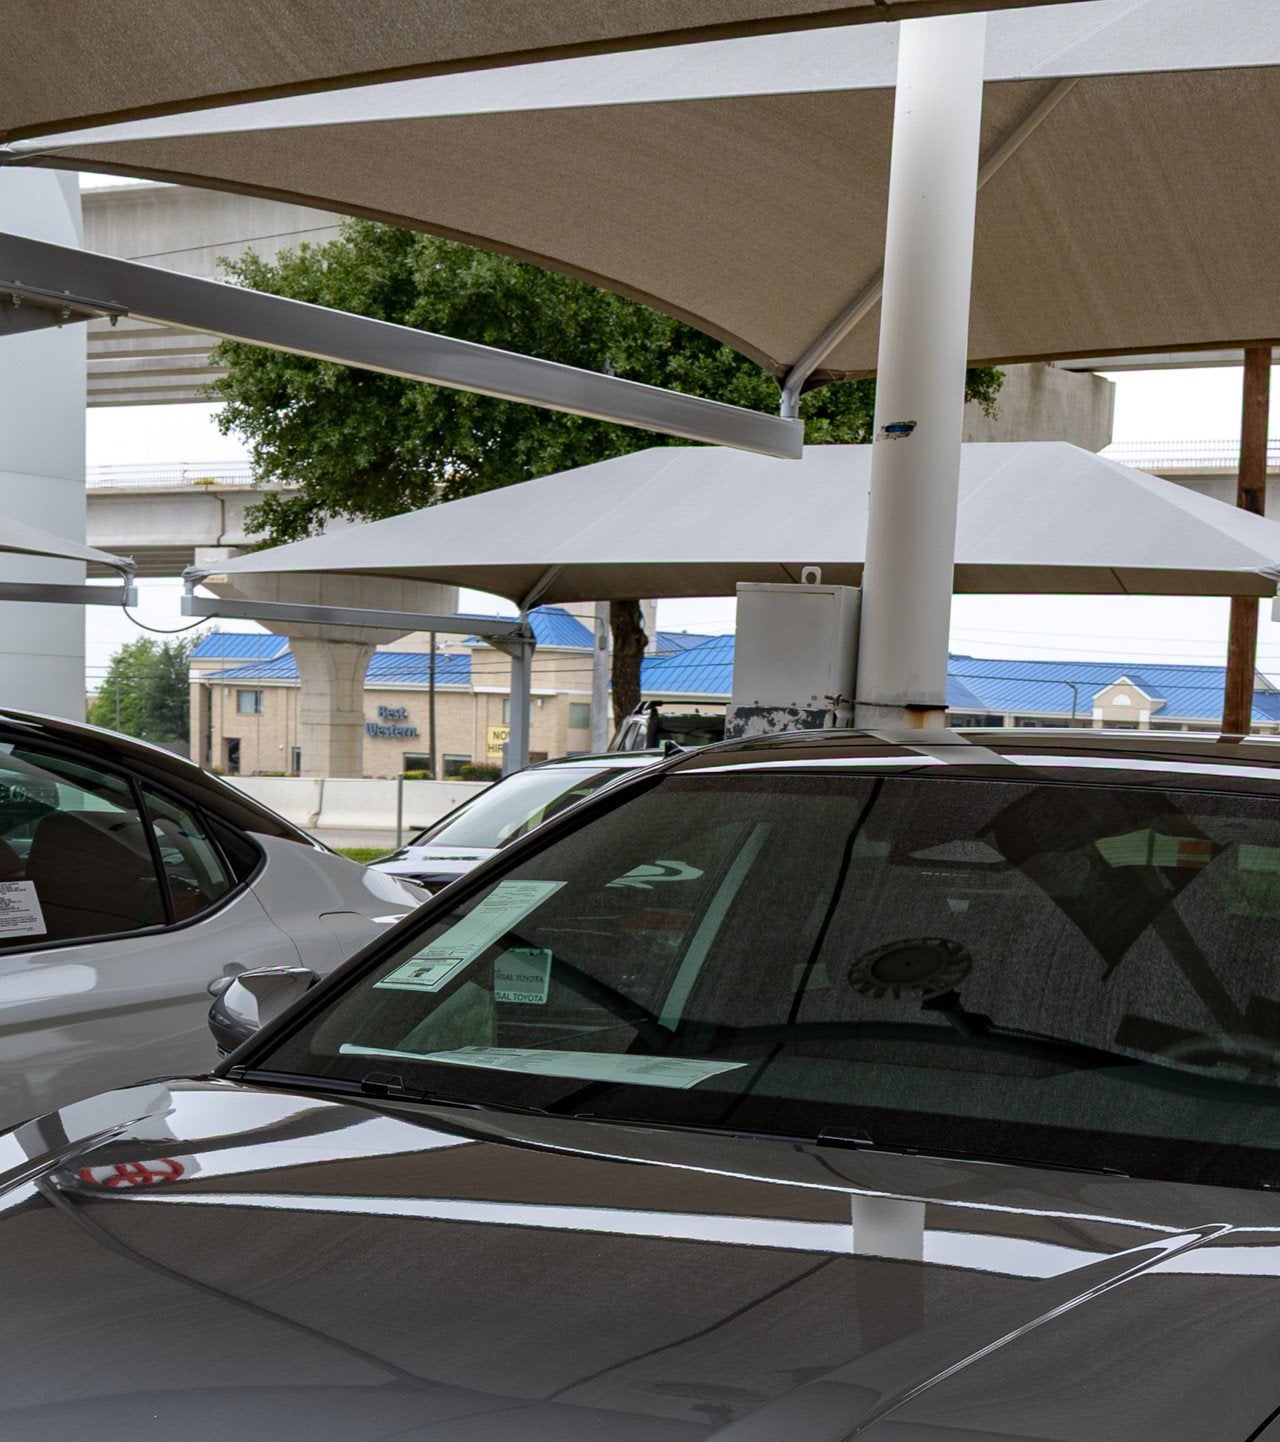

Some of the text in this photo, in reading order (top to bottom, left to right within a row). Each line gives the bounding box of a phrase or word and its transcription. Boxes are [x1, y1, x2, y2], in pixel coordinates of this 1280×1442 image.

[493, 730, 510, 741] NO
[487, 743, 504, 753] HIR
[516, 974, 544, 983] TOYOTA
[495, 991, 544, 1003] SAL TOYOTA
